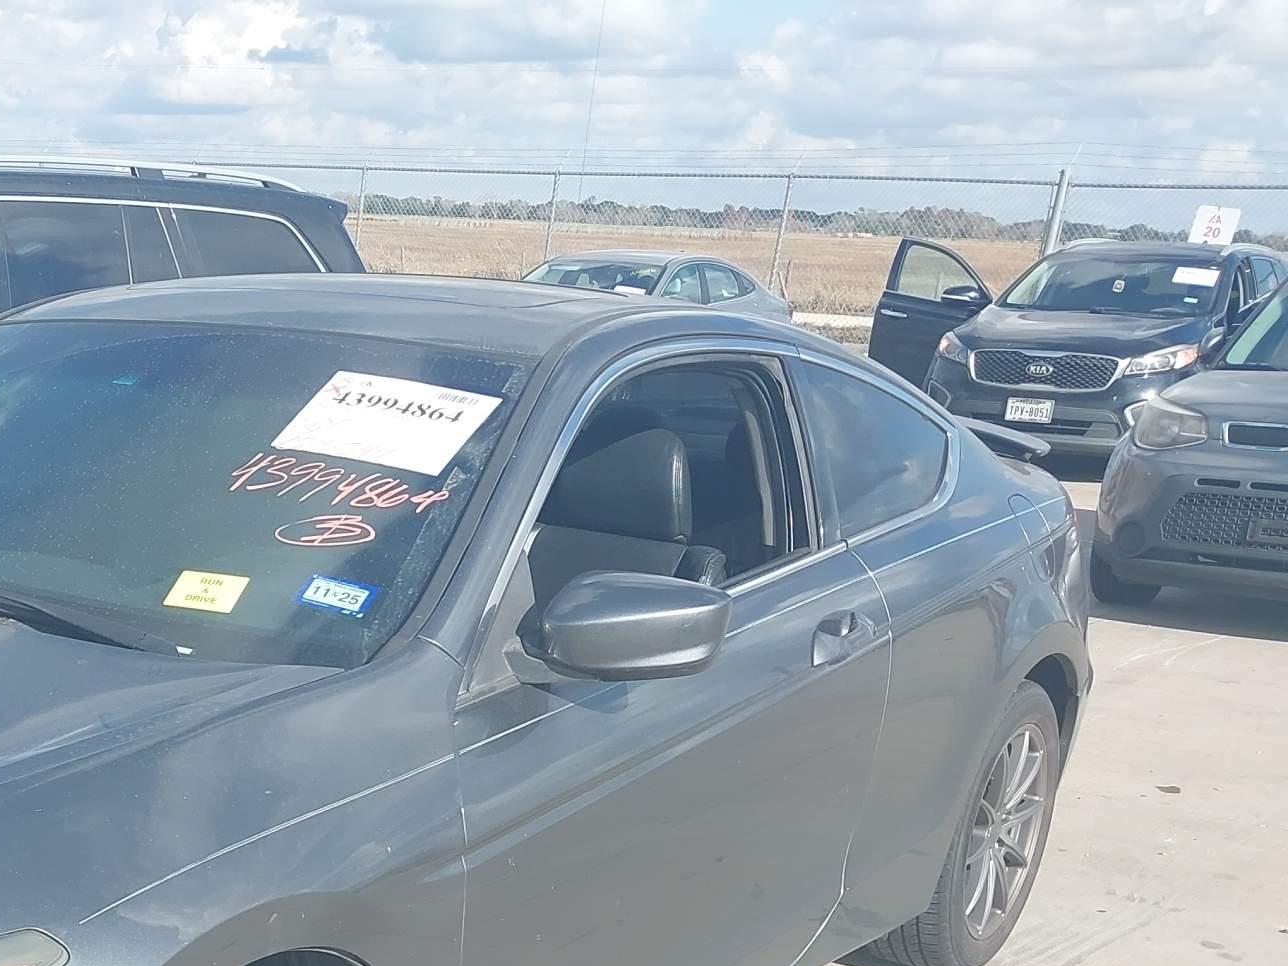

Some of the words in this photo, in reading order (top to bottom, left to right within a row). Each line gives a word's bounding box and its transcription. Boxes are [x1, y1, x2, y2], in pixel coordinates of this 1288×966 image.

[1203, 226, 1221, 239] 20
[1029, 365, 1047, 374] KIA
[329, 390, 465, 423] 43994864
[228, 452, 450, 514] 43994864
[199, 577, 224, 586] RUN
[184, 594, 217, 604] DRIVE
